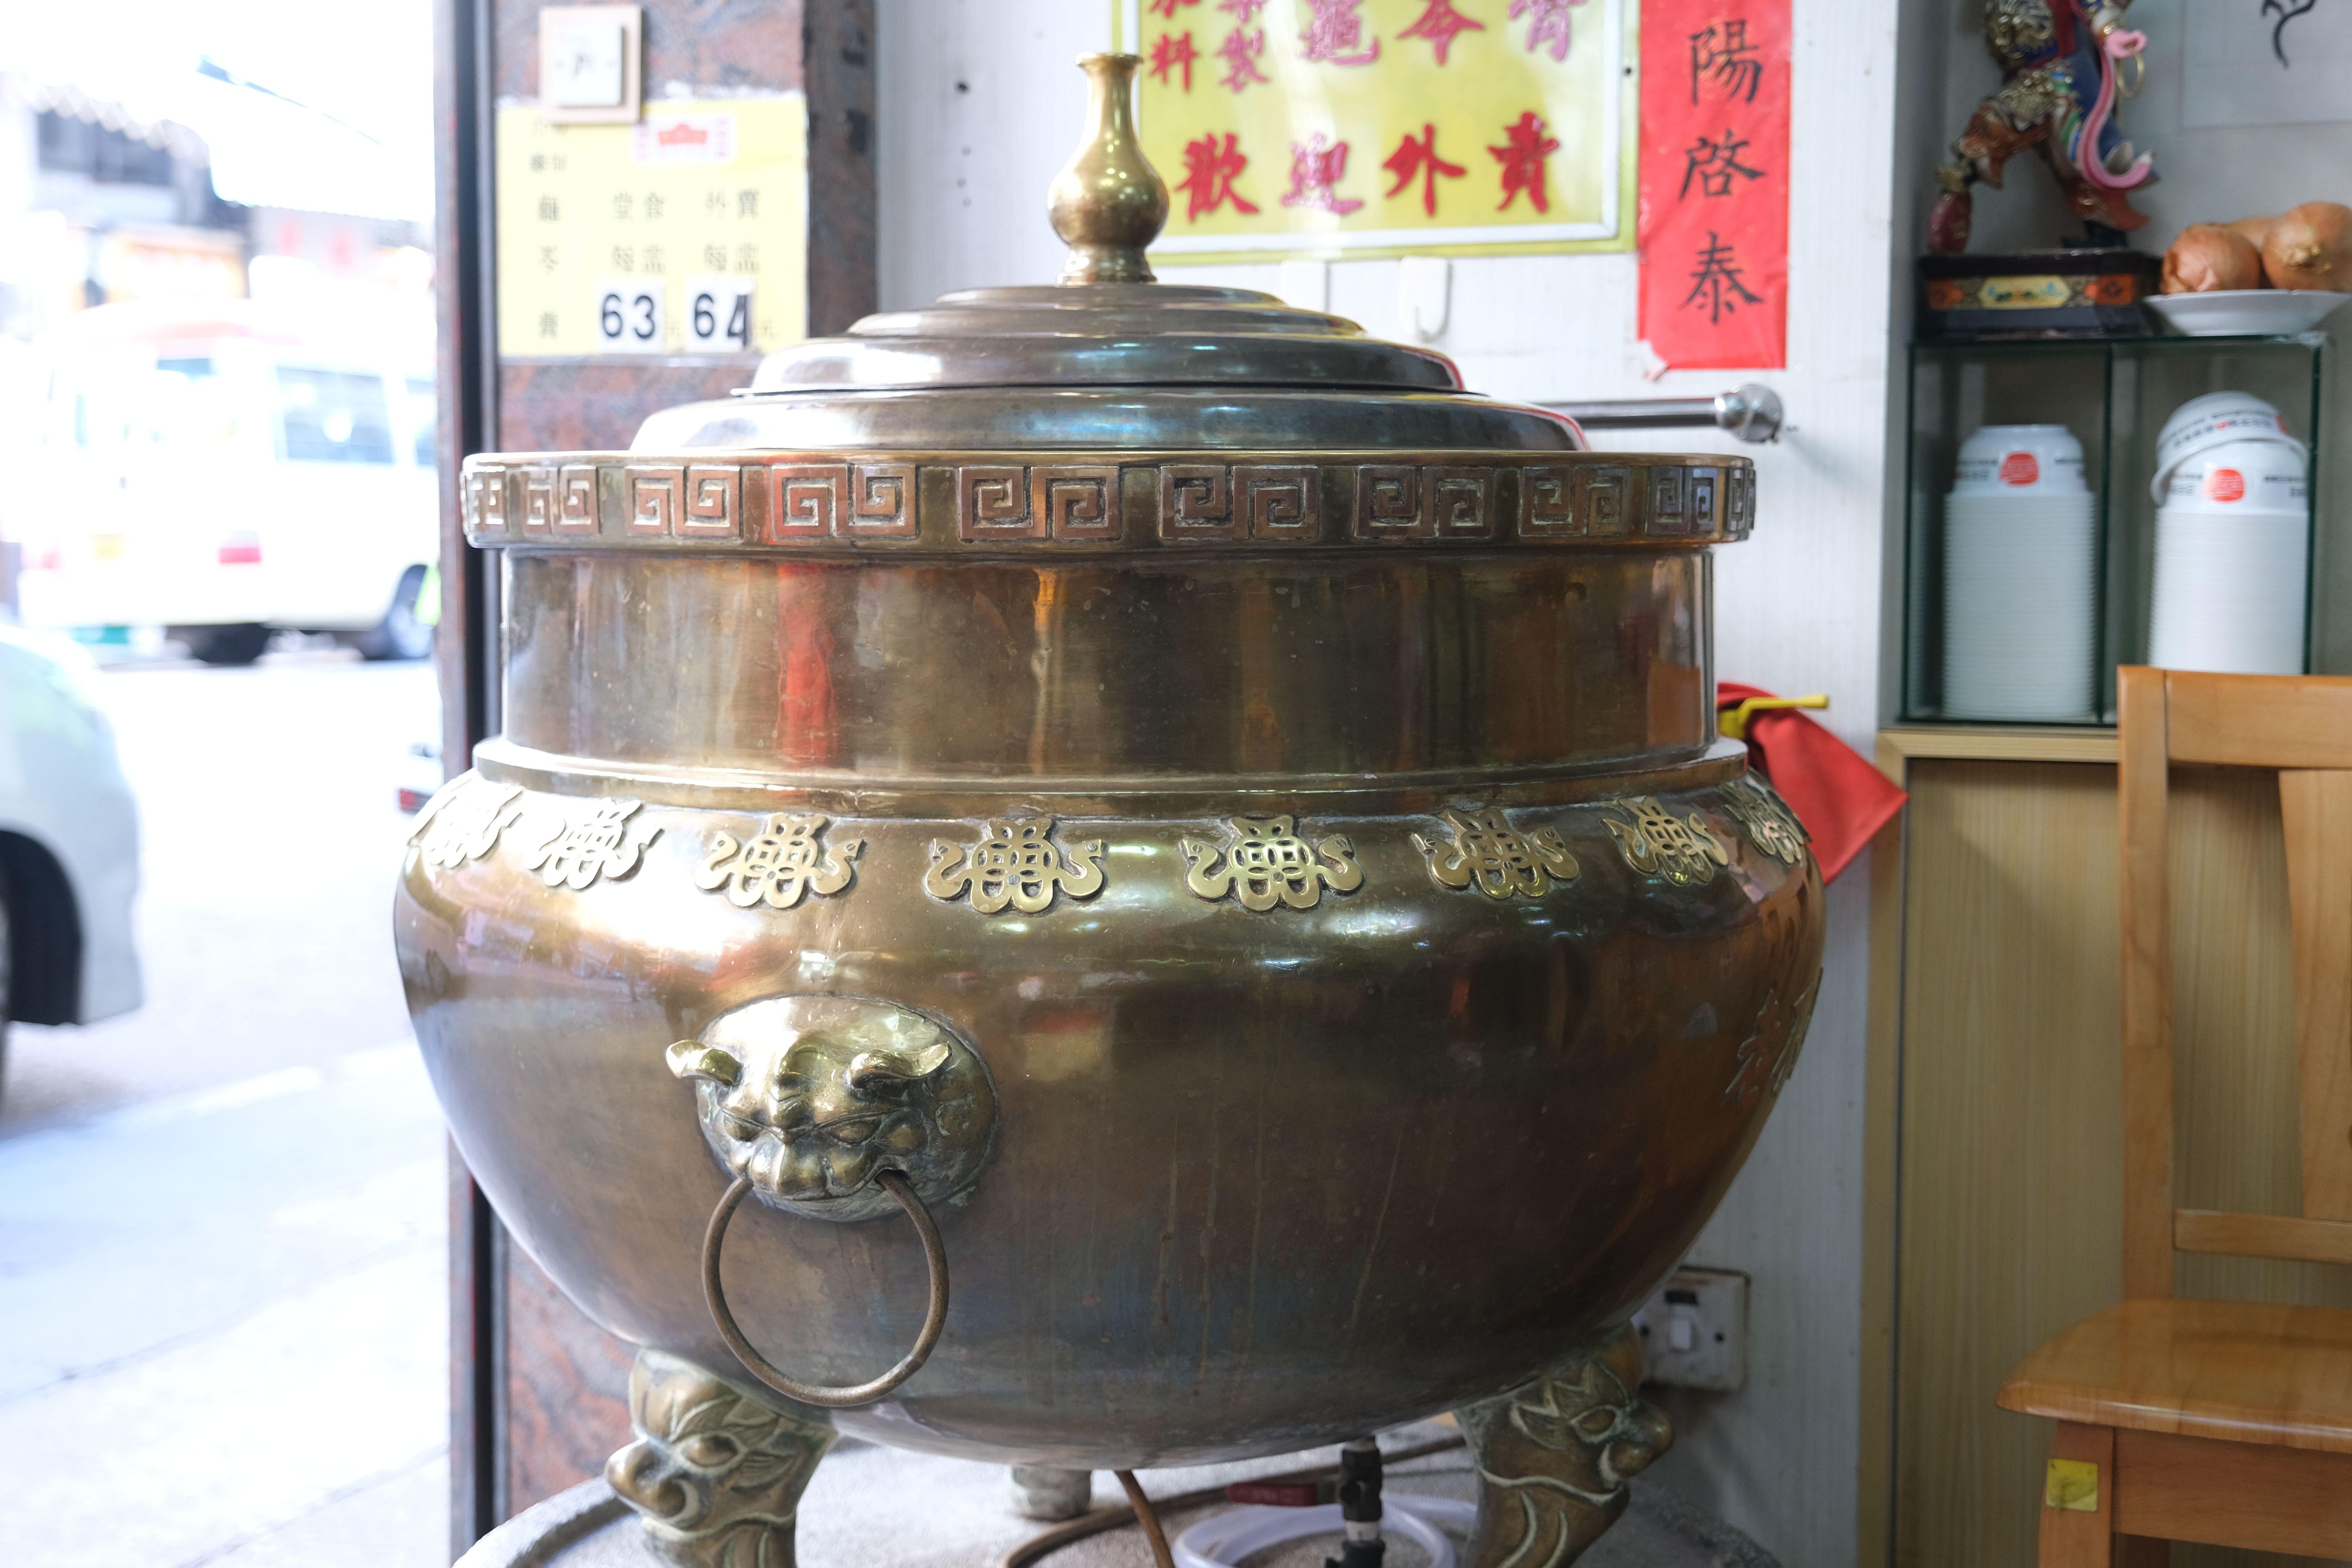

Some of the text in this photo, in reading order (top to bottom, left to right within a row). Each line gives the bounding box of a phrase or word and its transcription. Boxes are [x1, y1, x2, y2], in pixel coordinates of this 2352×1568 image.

[1174, 111, 1560, 222] 歡迎外賣
[602, 292, 657, 339] 63
[694, 292, 752, 348] 64
